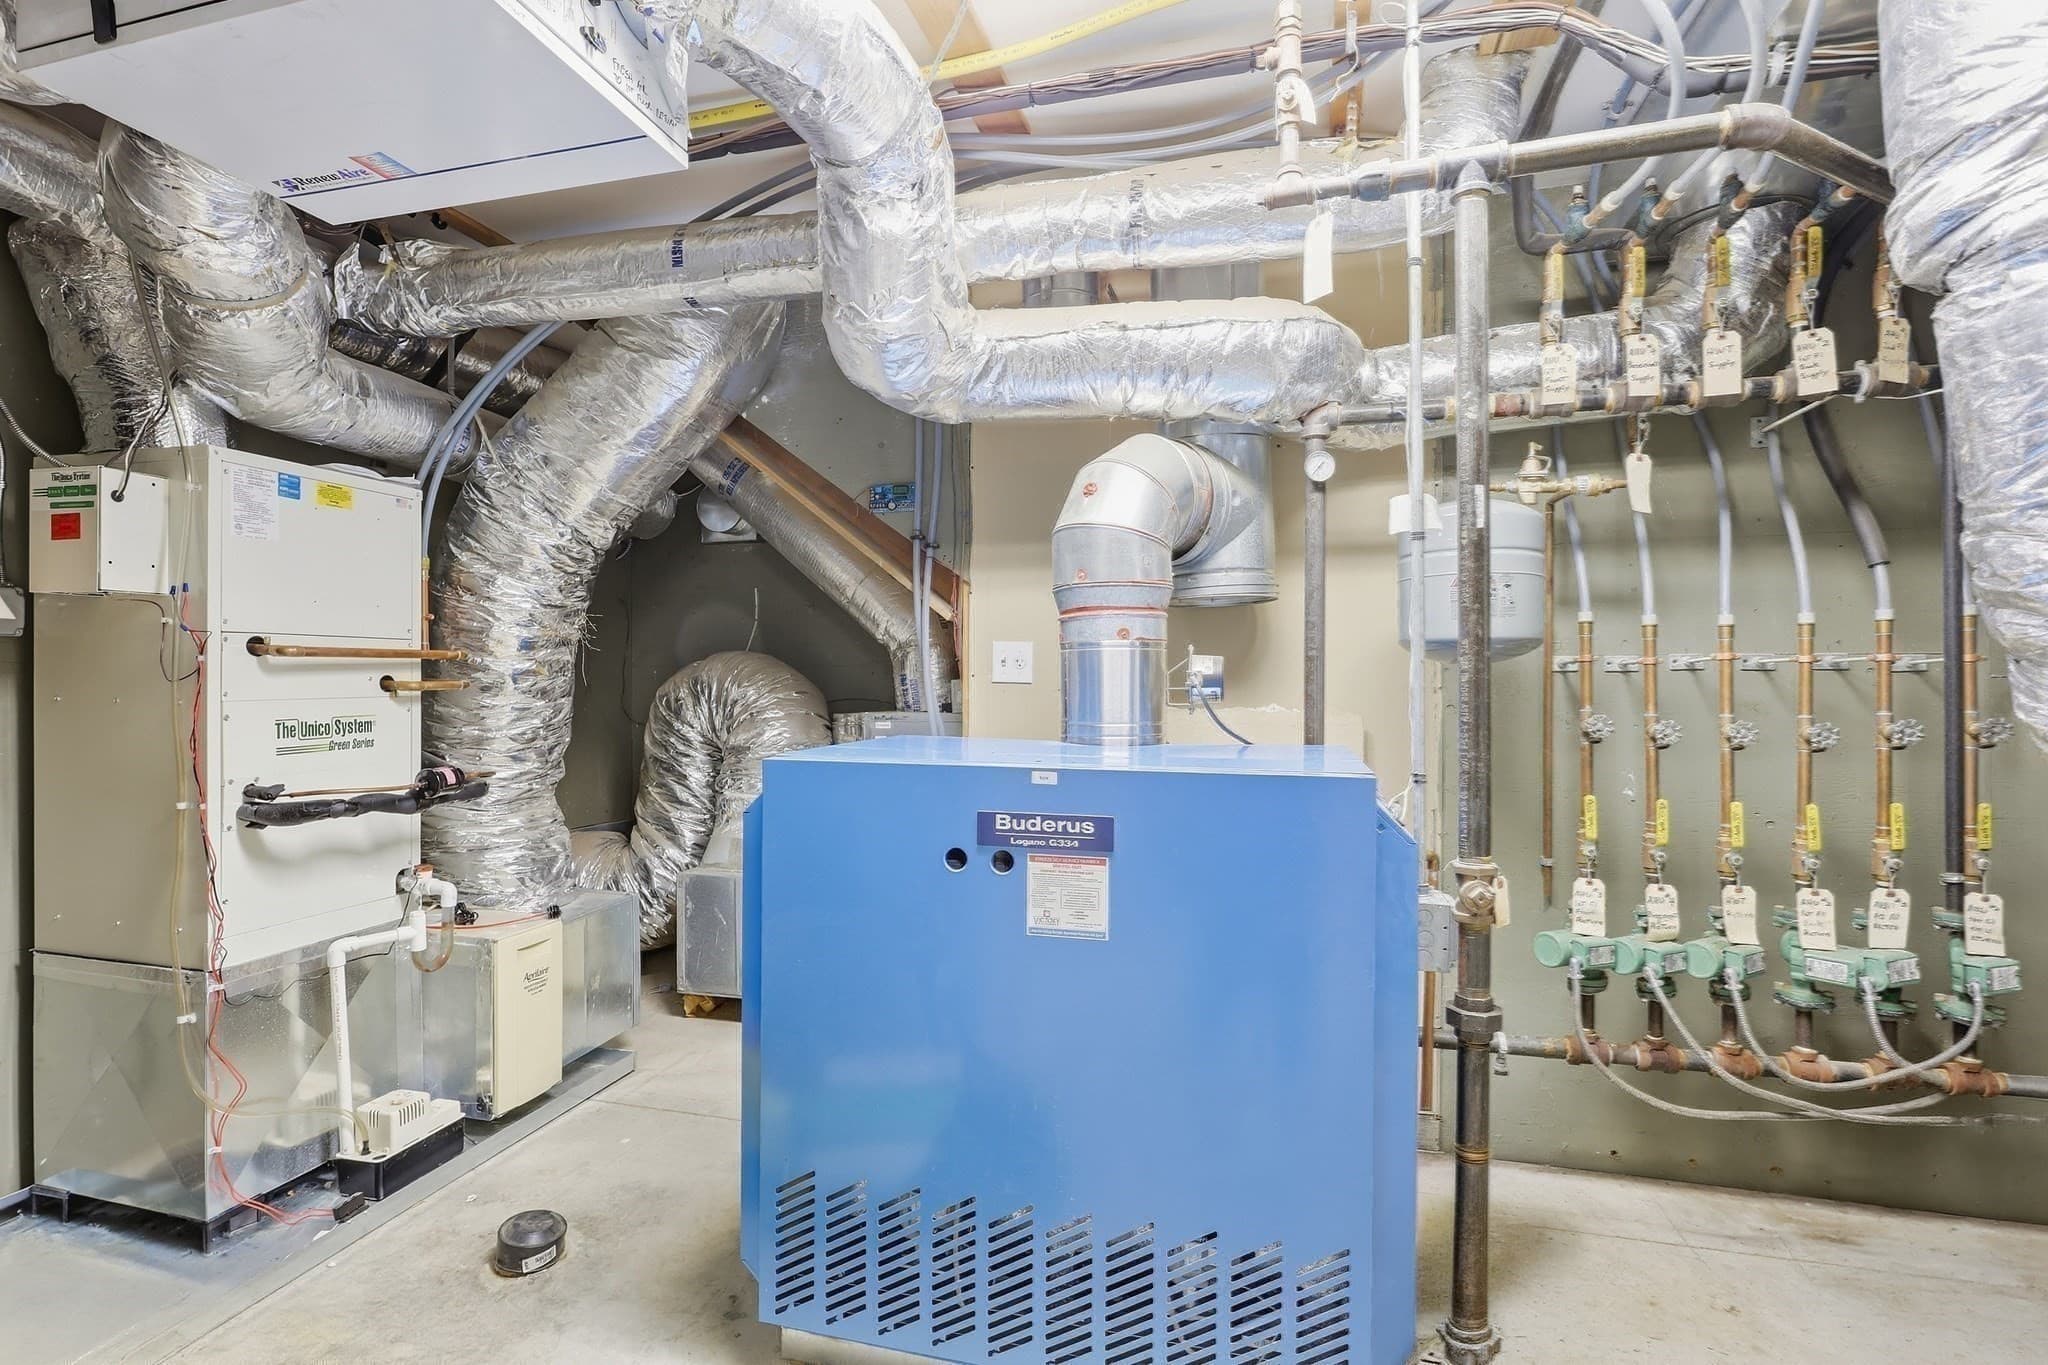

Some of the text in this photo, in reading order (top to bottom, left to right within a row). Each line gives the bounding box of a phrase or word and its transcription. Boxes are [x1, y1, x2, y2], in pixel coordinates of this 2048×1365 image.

[292, 168, 370, 187] RenewAire
[275, 718, 374, 740] The Unico System
[328, 737, 375, 752] Green Series
[995, 813, 1096, 834] Buderus
[1010, 836, 1079, 848] Logano G334
